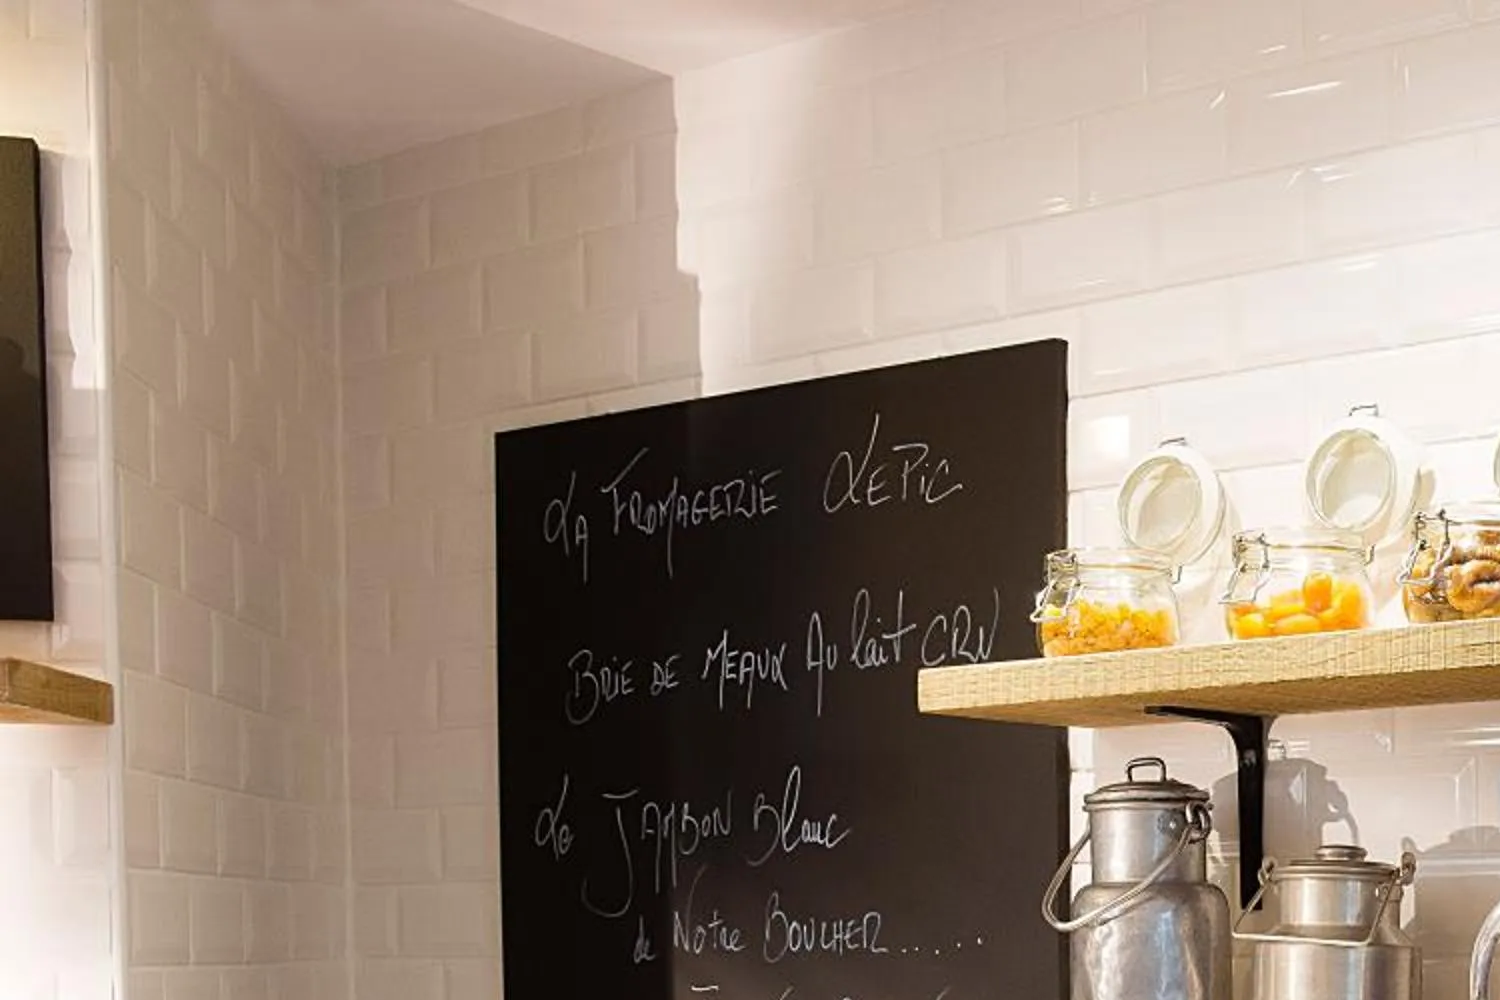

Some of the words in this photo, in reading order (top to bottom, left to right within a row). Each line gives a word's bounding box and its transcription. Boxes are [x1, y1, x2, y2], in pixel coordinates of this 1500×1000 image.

[650, 653, 684, 696] DE
[701, 628, 789, 711] MEAUX
[850, 587, 917, 669] lait
